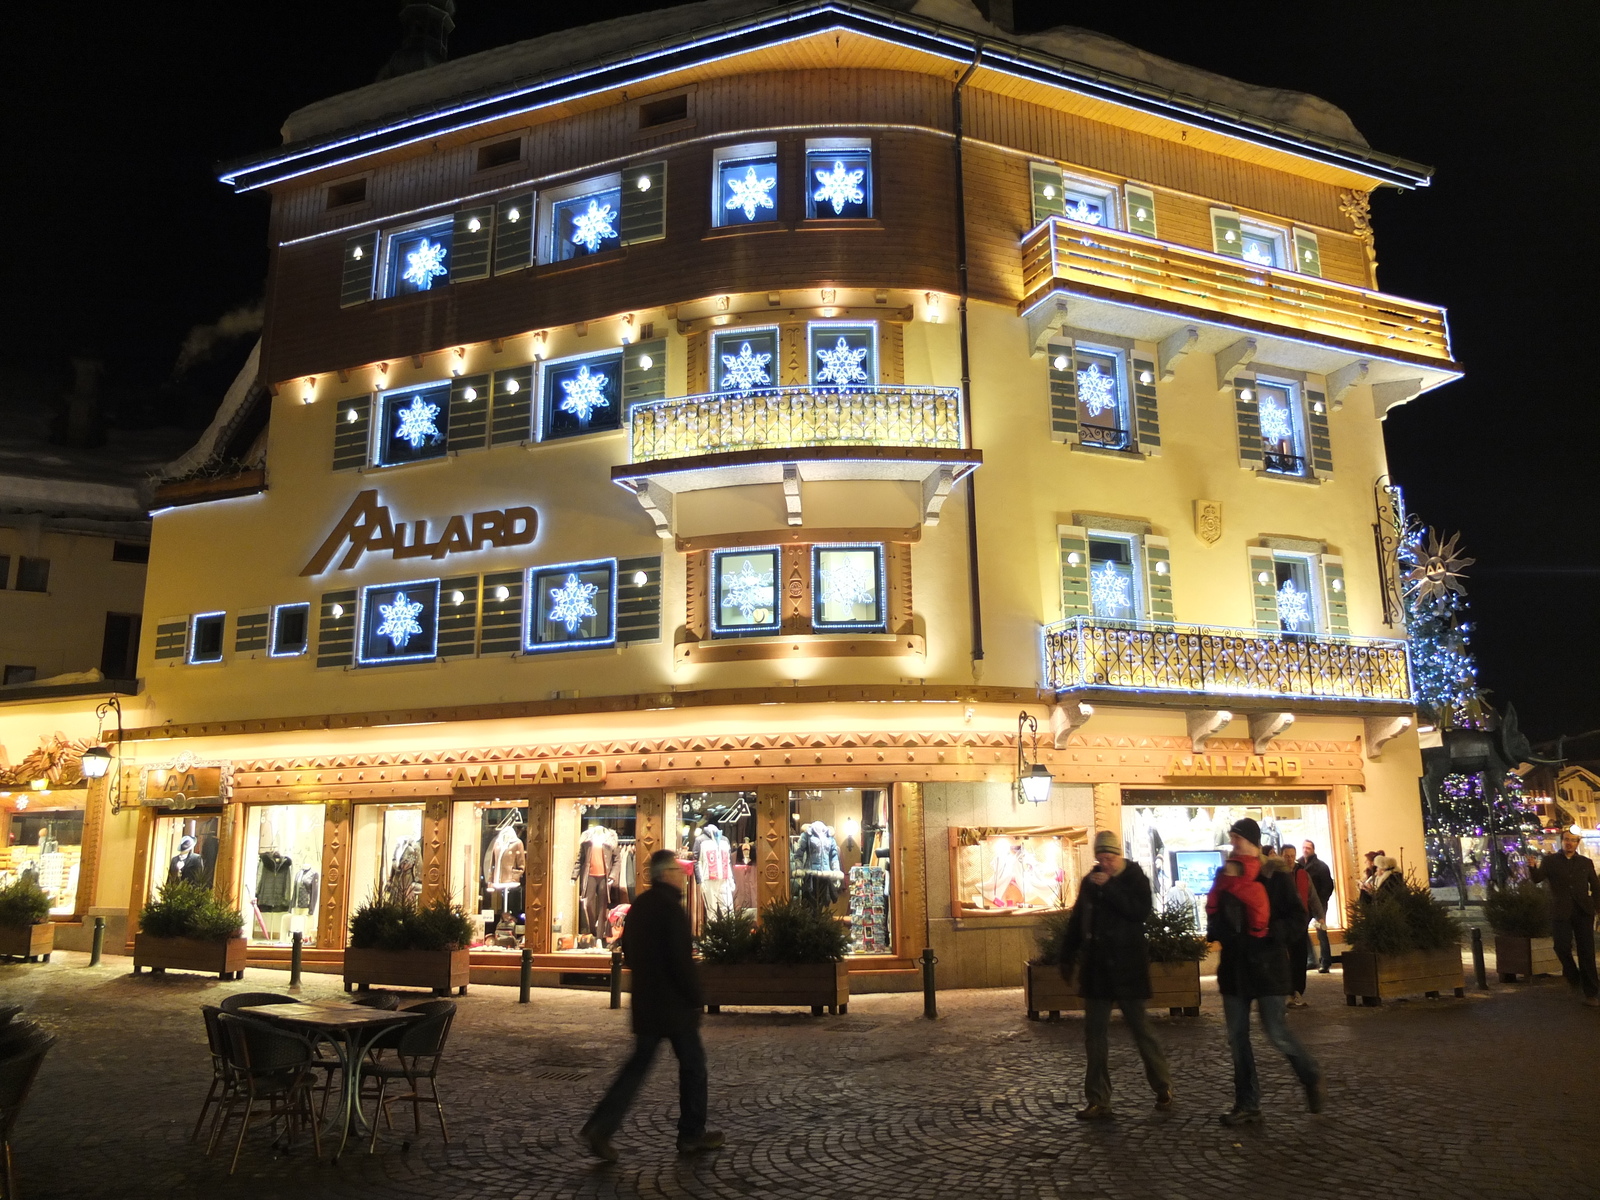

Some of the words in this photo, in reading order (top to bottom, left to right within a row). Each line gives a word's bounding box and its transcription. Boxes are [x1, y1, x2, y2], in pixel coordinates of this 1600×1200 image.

[451, 760, 605, 787] AALLARD
[1167, 755, 1302, 777] AALLARD
[164, 774, 198, 792] AA
